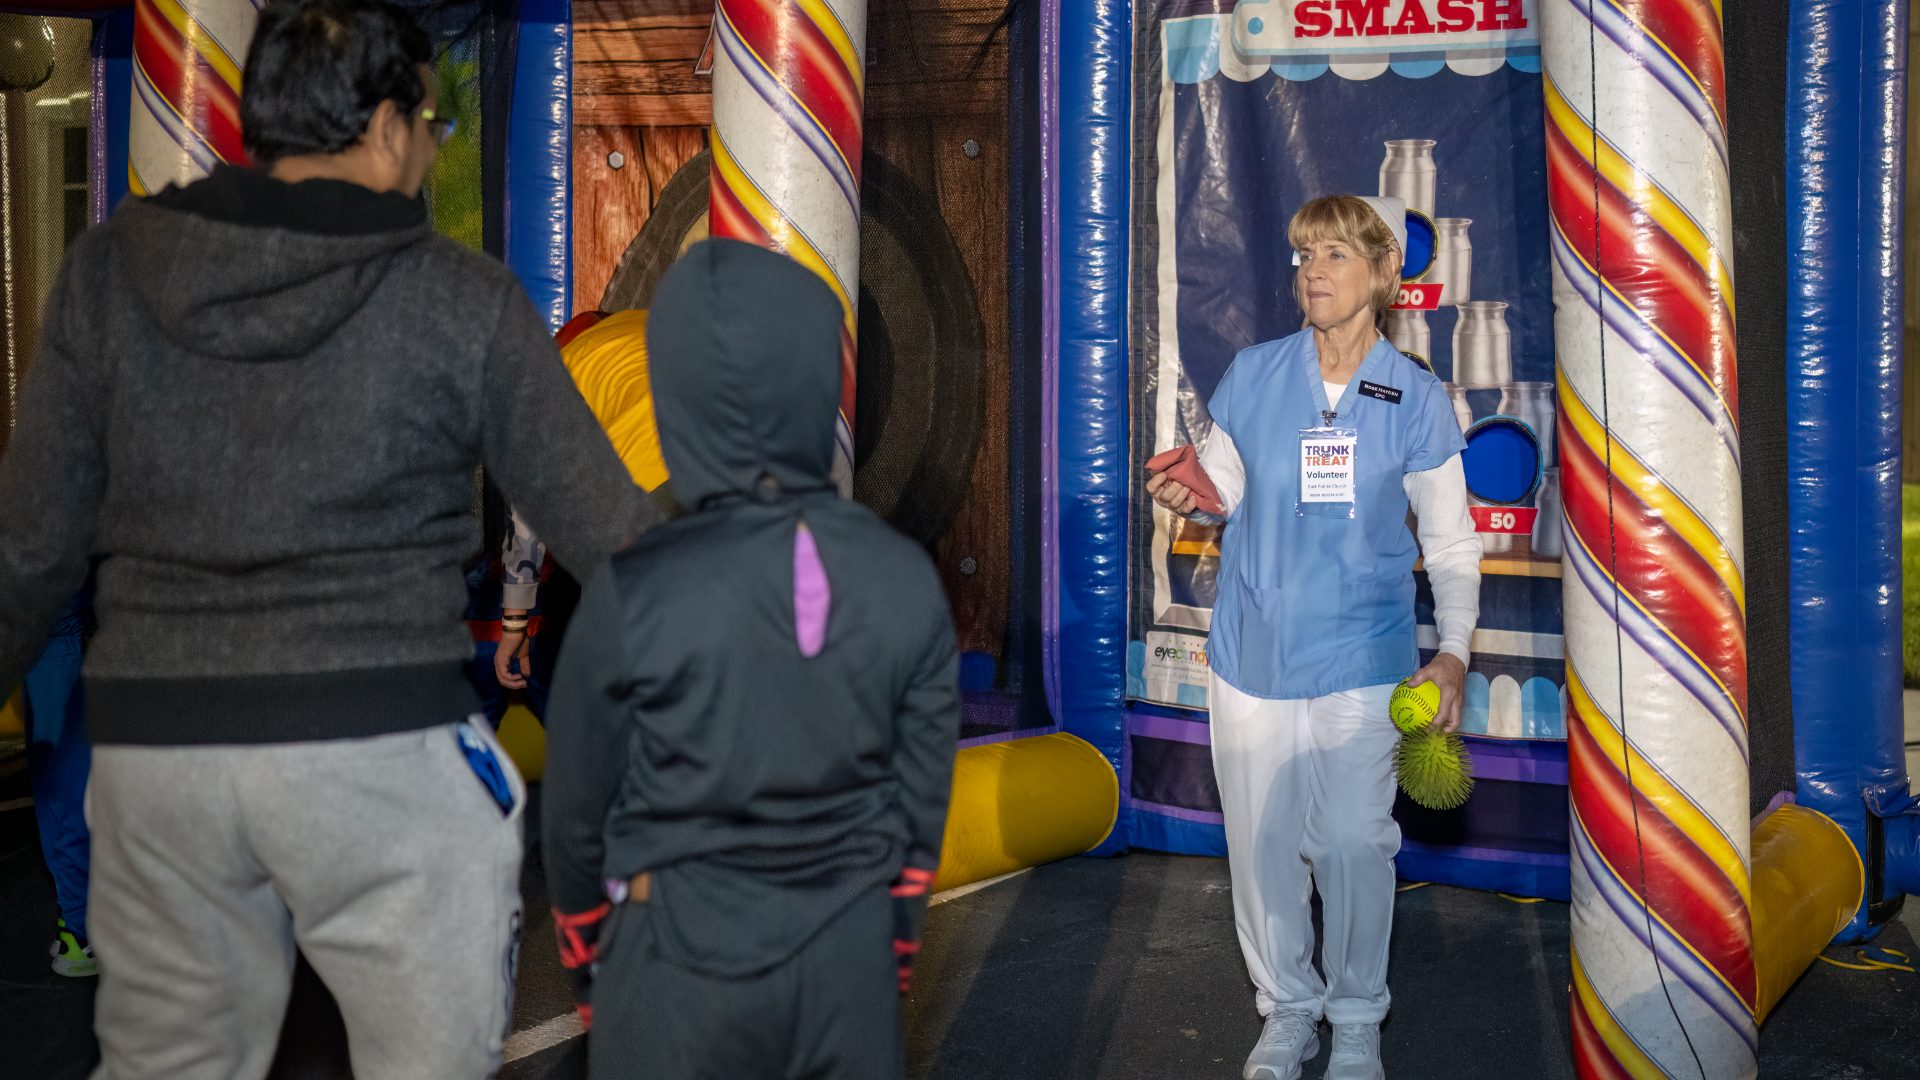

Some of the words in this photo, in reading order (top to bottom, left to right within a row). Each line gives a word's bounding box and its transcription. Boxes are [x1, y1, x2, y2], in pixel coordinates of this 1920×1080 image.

[1294, 0, 1528, 38] SMASH
[1396, 288, 1424, 306] 00
[1305, 445, 1349, 456] TRUNK
[1305, 455, 1349, 466] TREAT
[1306, 470, 1348, 479] Volunteer
[1489, 511, 1516, 530] 50
